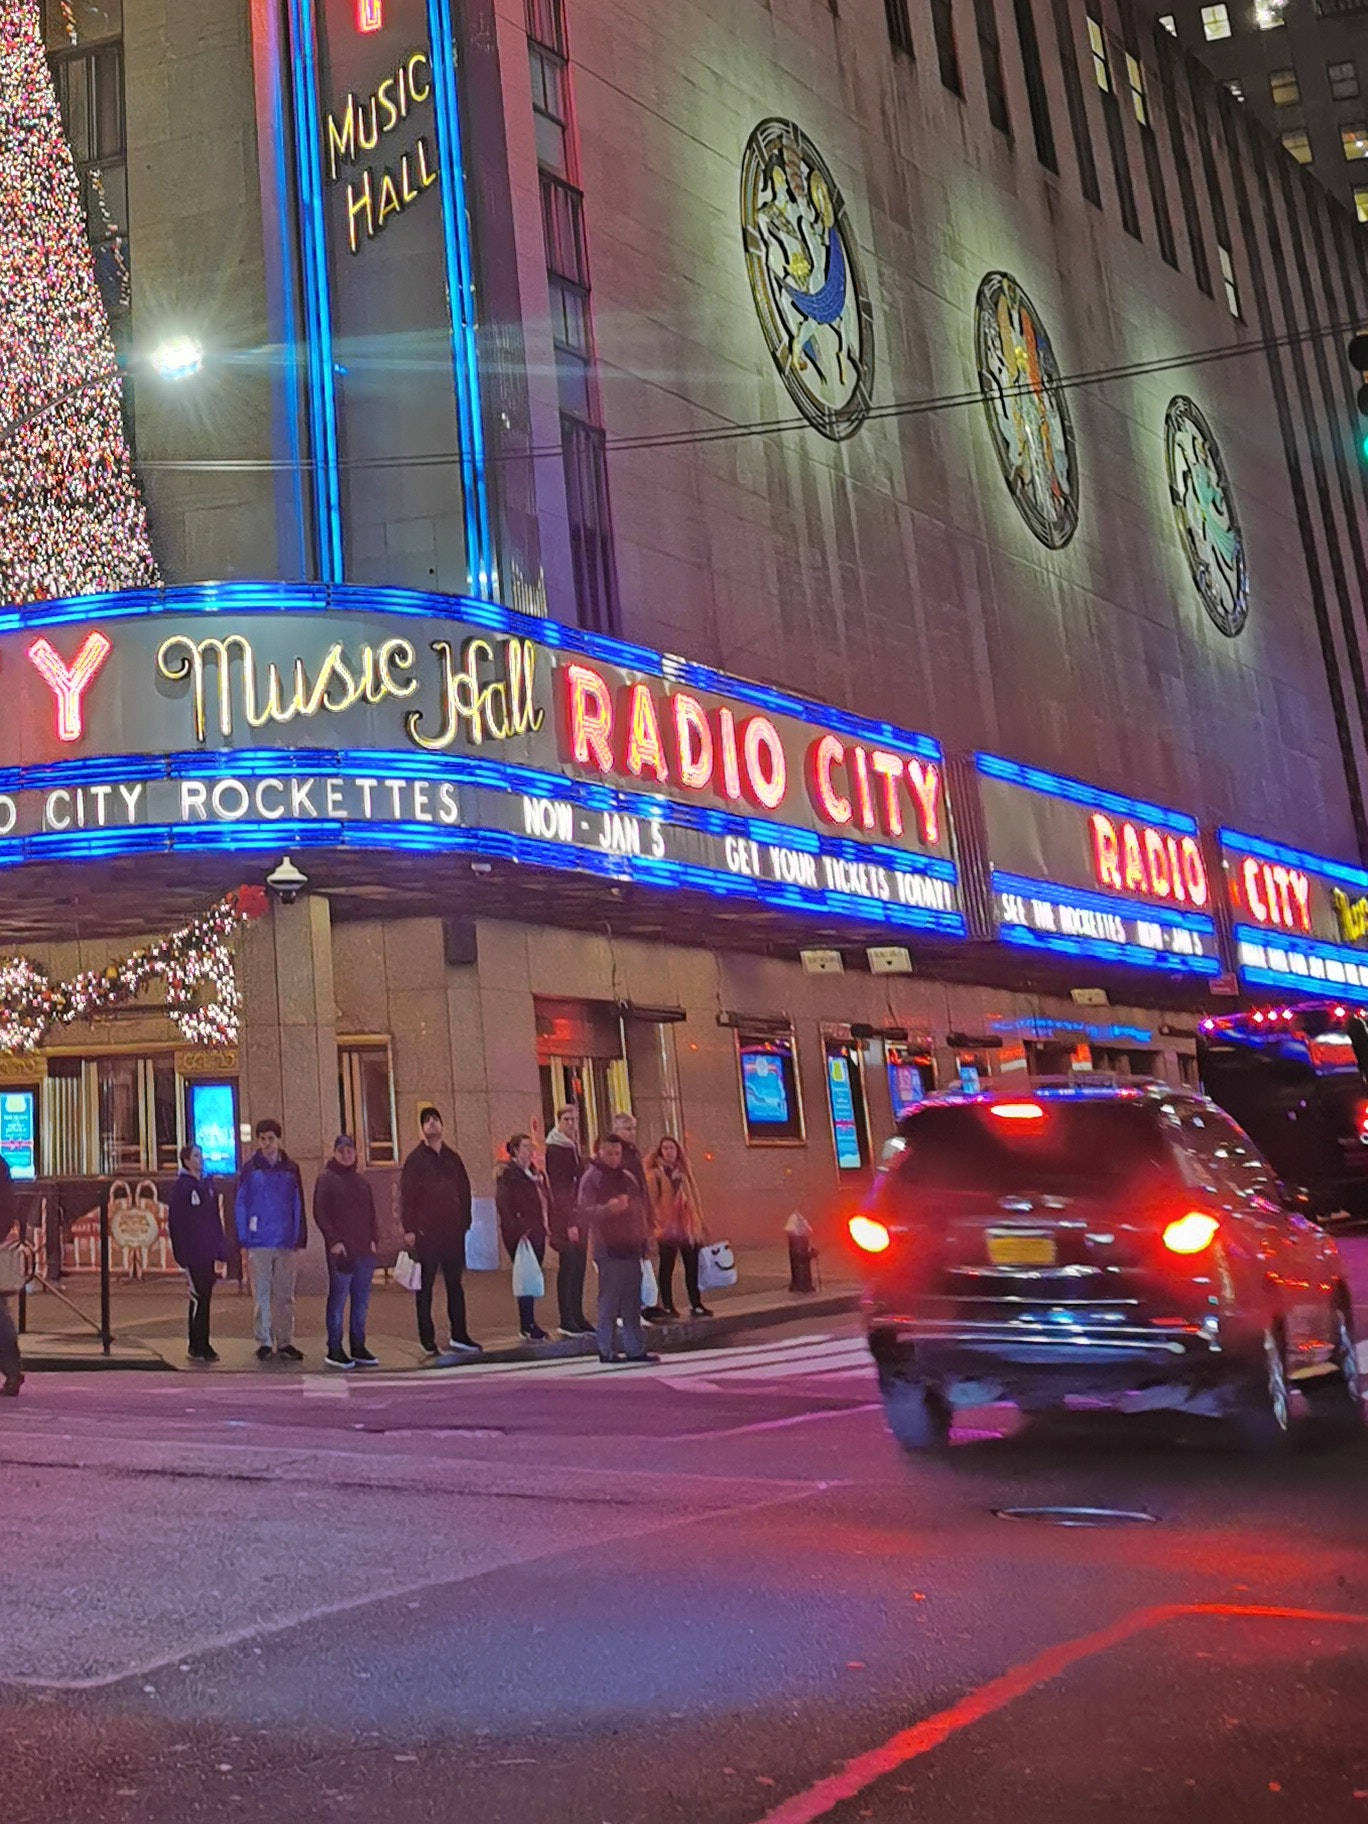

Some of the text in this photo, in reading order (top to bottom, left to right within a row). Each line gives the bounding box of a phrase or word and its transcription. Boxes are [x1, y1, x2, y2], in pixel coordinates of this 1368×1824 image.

[157, 632, 545, 750] Music Hall
[563, 662, 942, 845] RADIO CITY
[45, 783, 143, 831] CITY
[180, 777, 460, 825] ROCKETTES
[523, 797, 573, 840] NOW
[598, 813, 641, 854] JAN
[651, 821, 666, 858] 5
[725, 835, 952, 910] GET YOUR TICKETS TODAY!
[1089, 812, 1209, 907] RADIO
[1241, 855, 1312, 934] CITY
